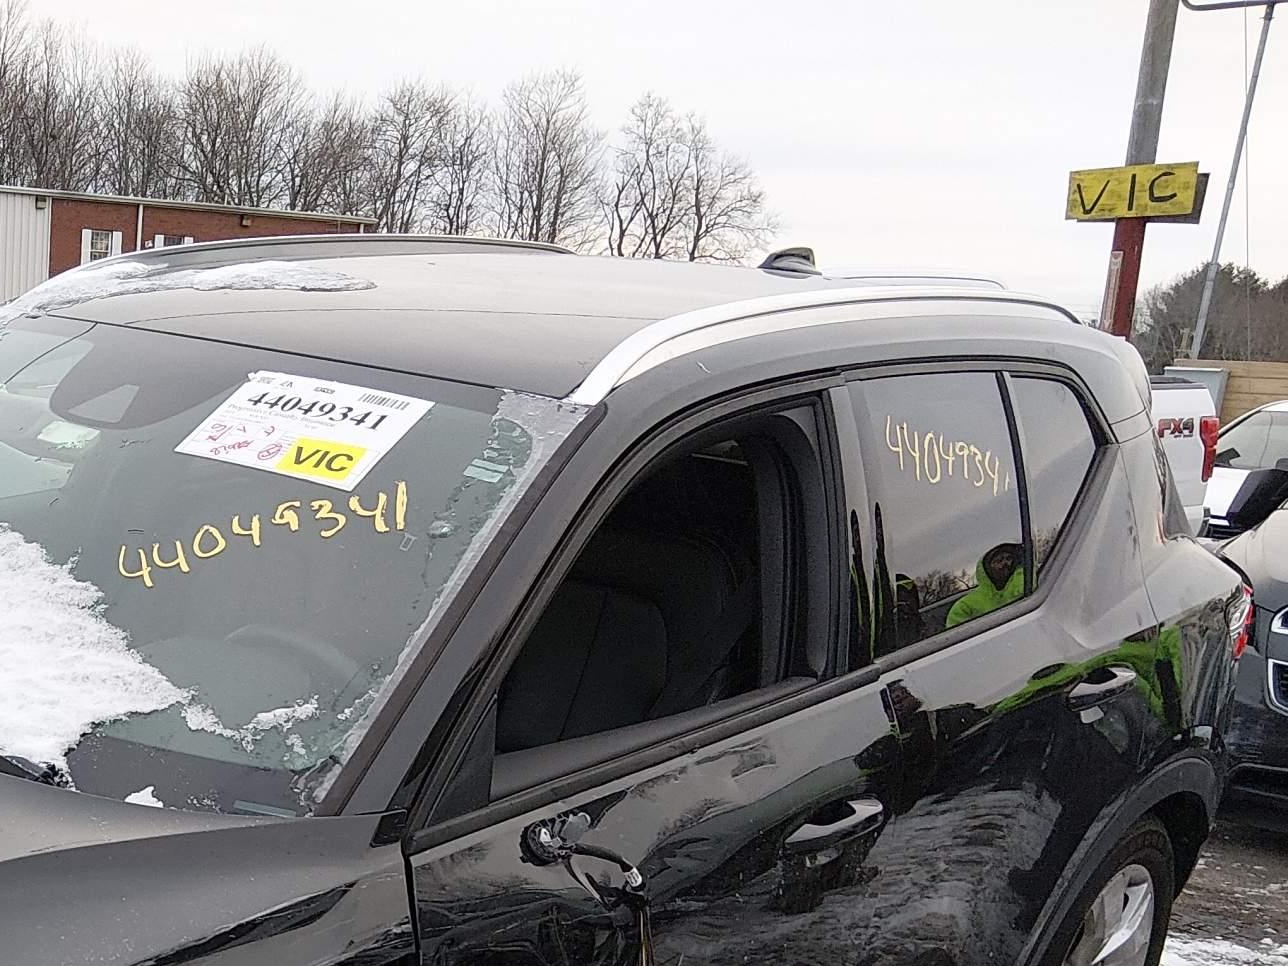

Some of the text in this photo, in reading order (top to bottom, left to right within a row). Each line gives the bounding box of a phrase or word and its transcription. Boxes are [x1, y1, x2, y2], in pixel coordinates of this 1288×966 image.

[1076, 170, 1178, 215] VIC
[247, 391, 389, 431] 44049341
[1158, 417, 1195, 438] FX4
[293, 445, 355, 473] VIC
[118, 480, 408, 588] 44049341
